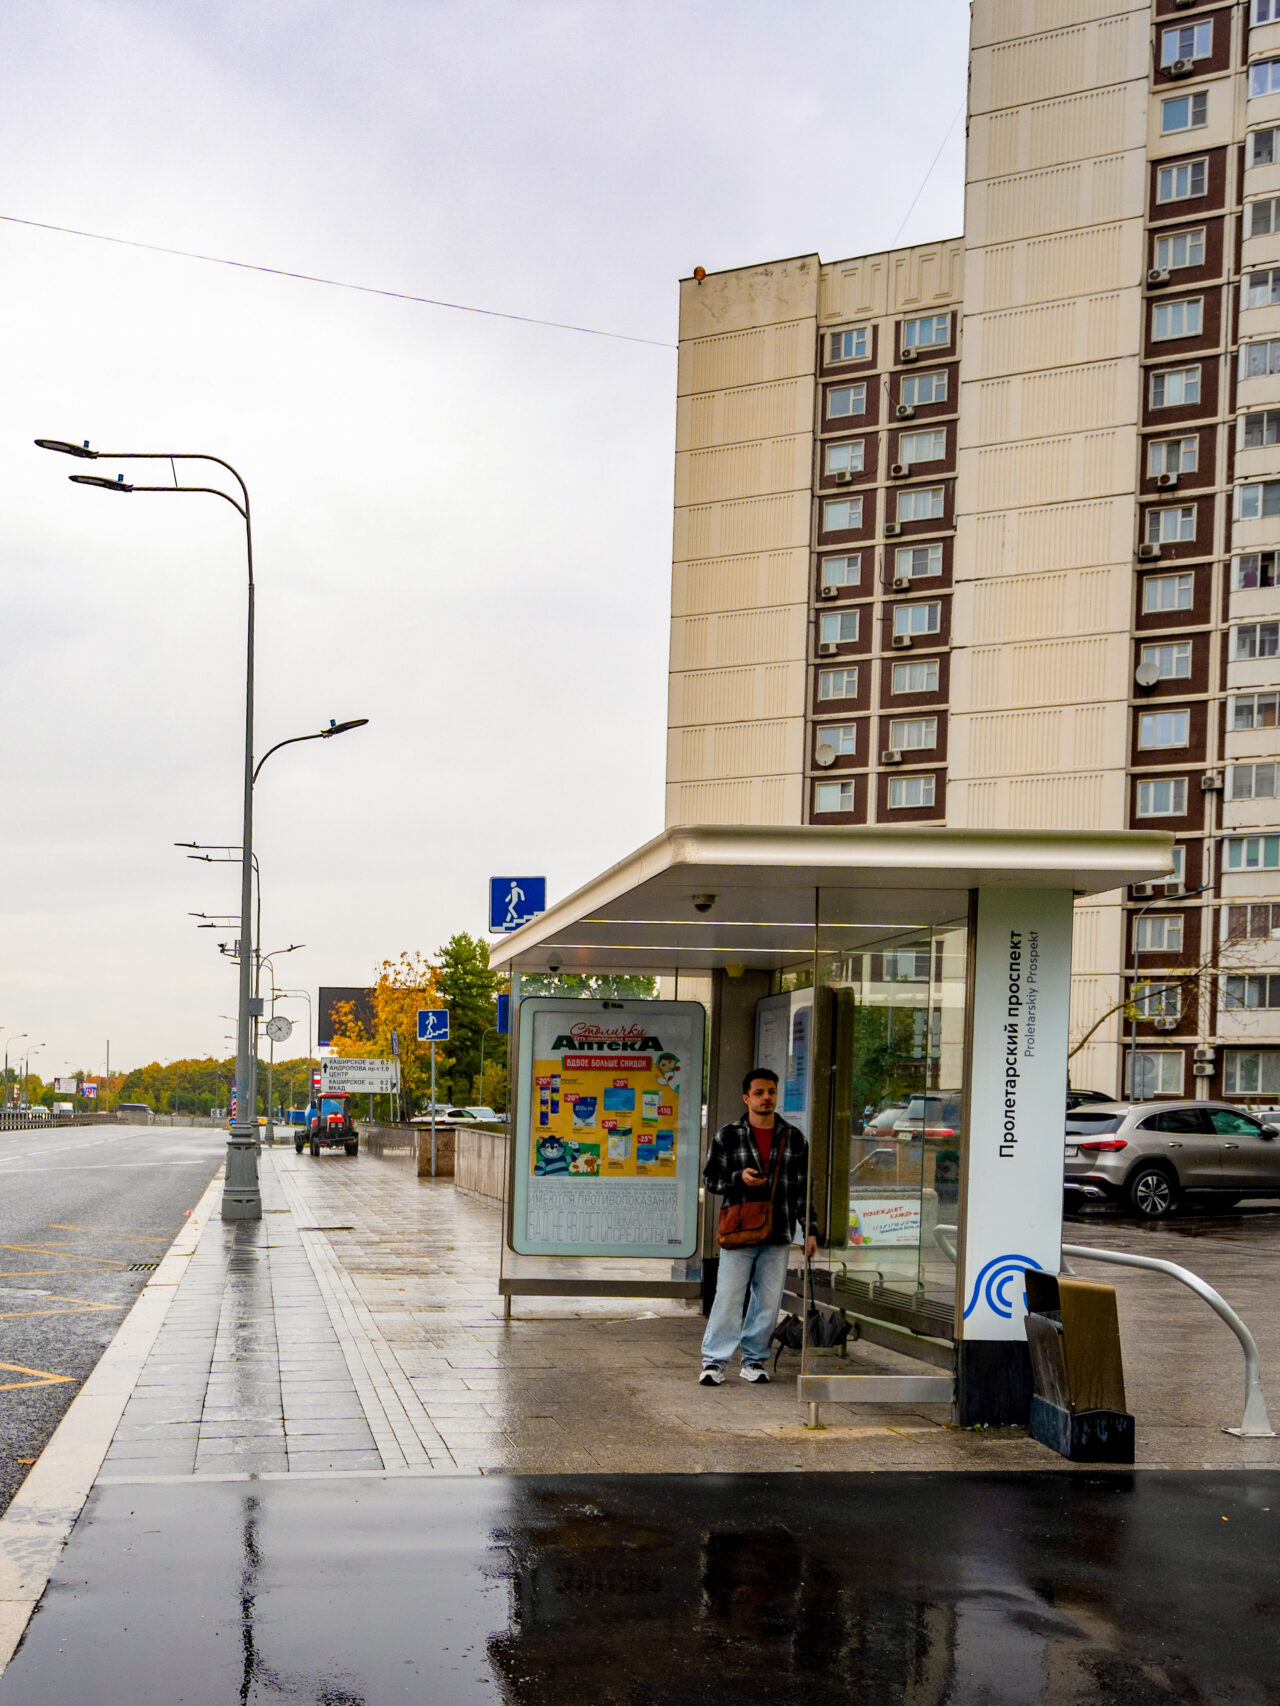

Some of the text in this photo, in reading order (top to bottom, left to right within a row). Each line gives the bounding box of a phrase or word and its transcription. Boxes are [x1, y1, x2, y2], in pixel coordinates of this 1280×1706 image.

[1024, 931, 1040, 1057] Proletarskiy Prospekt
[570, 1022, 647, 1036] Столички
[999, 930, 1023, 1158] Пролетарский проспект
[567, 1059, 647, 1068] ВДВОЕ БОЛЬШЕ СКИДОК
[528, 1193, 678, 1206] ИМЕЮТСЯ ПРОТИВОПОКАЗАНИЯ
